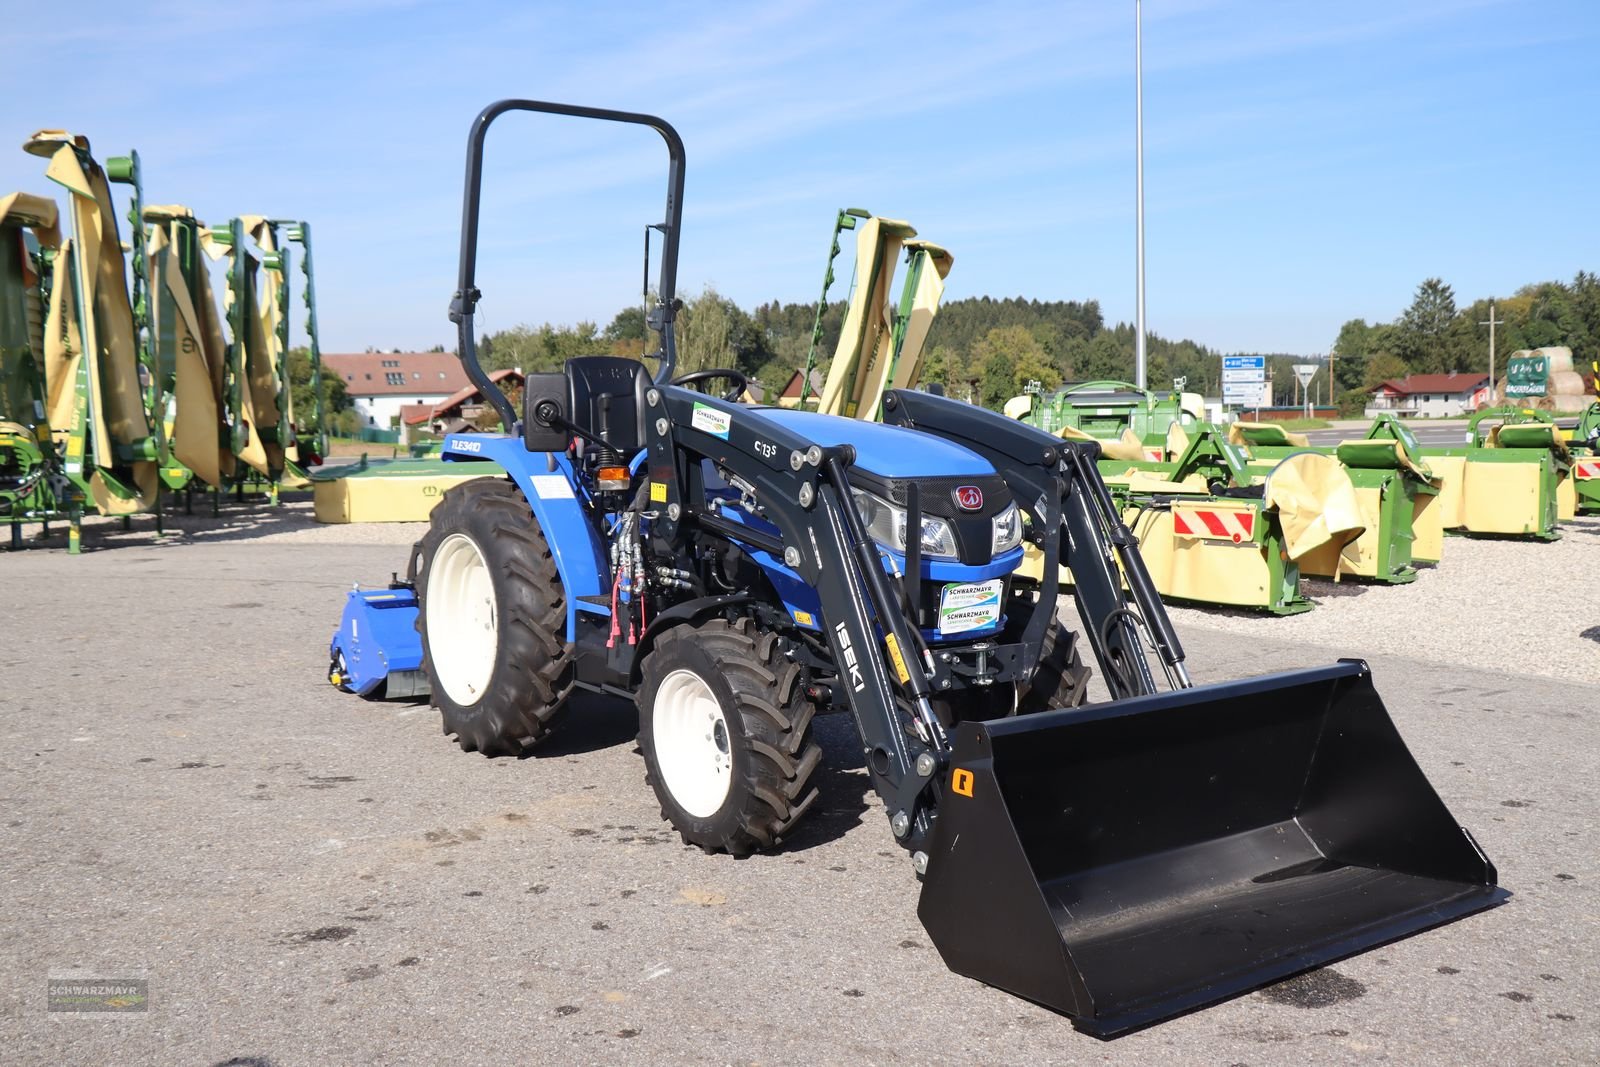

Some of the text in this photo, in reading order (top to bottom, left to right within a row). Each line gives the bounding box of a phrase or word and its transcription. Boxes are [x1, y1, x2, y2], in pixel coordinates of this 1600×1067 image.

[696, 409, 725, 424] SCHWARZMAYR
[452, 440, 481, 452] TLE3410
[949, 586, 992, 595] SCHWARZMAYR
[947, 610, 990, 620] SCHWARZMAYR
[835, 621, 865, 693] ISEKI
